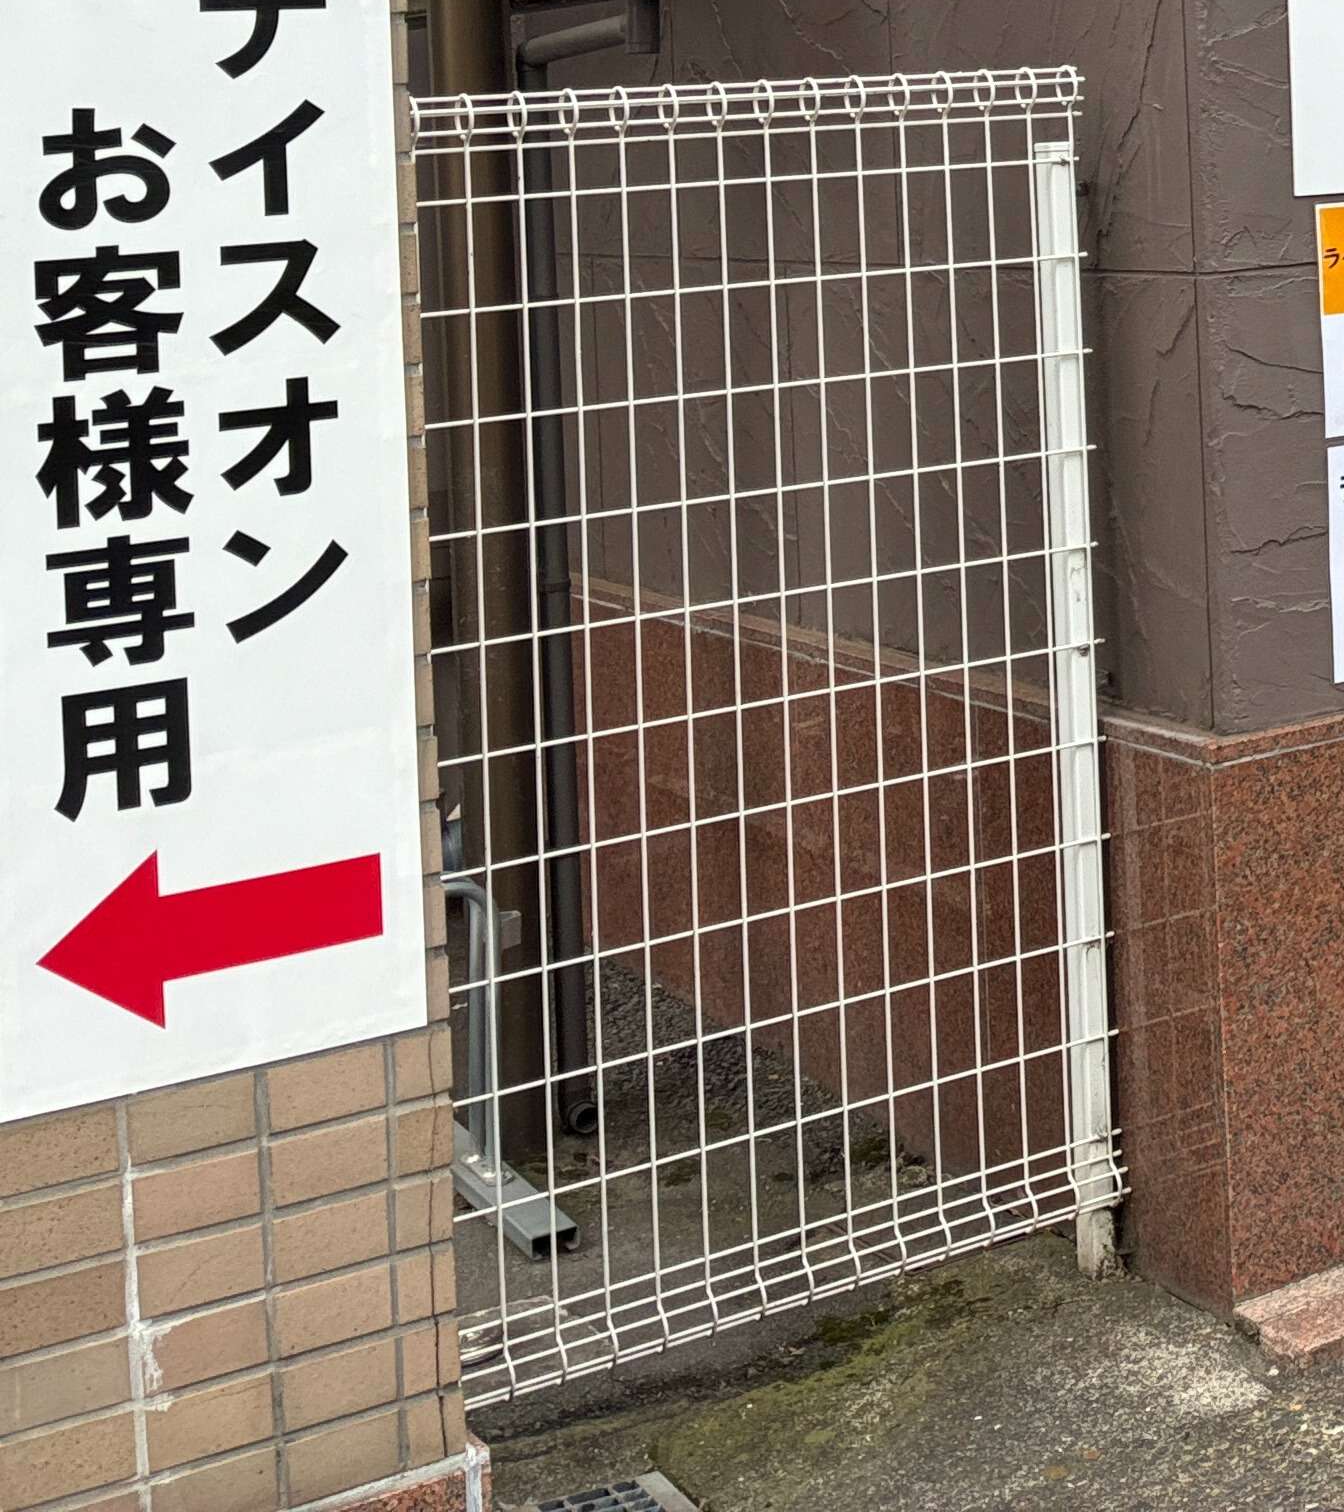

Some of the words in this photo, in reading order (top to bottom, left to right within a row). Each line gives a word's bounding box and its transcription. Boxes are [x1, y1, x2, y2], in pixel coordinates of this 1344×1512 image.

[34, 108, 194, 821] お客様専用
